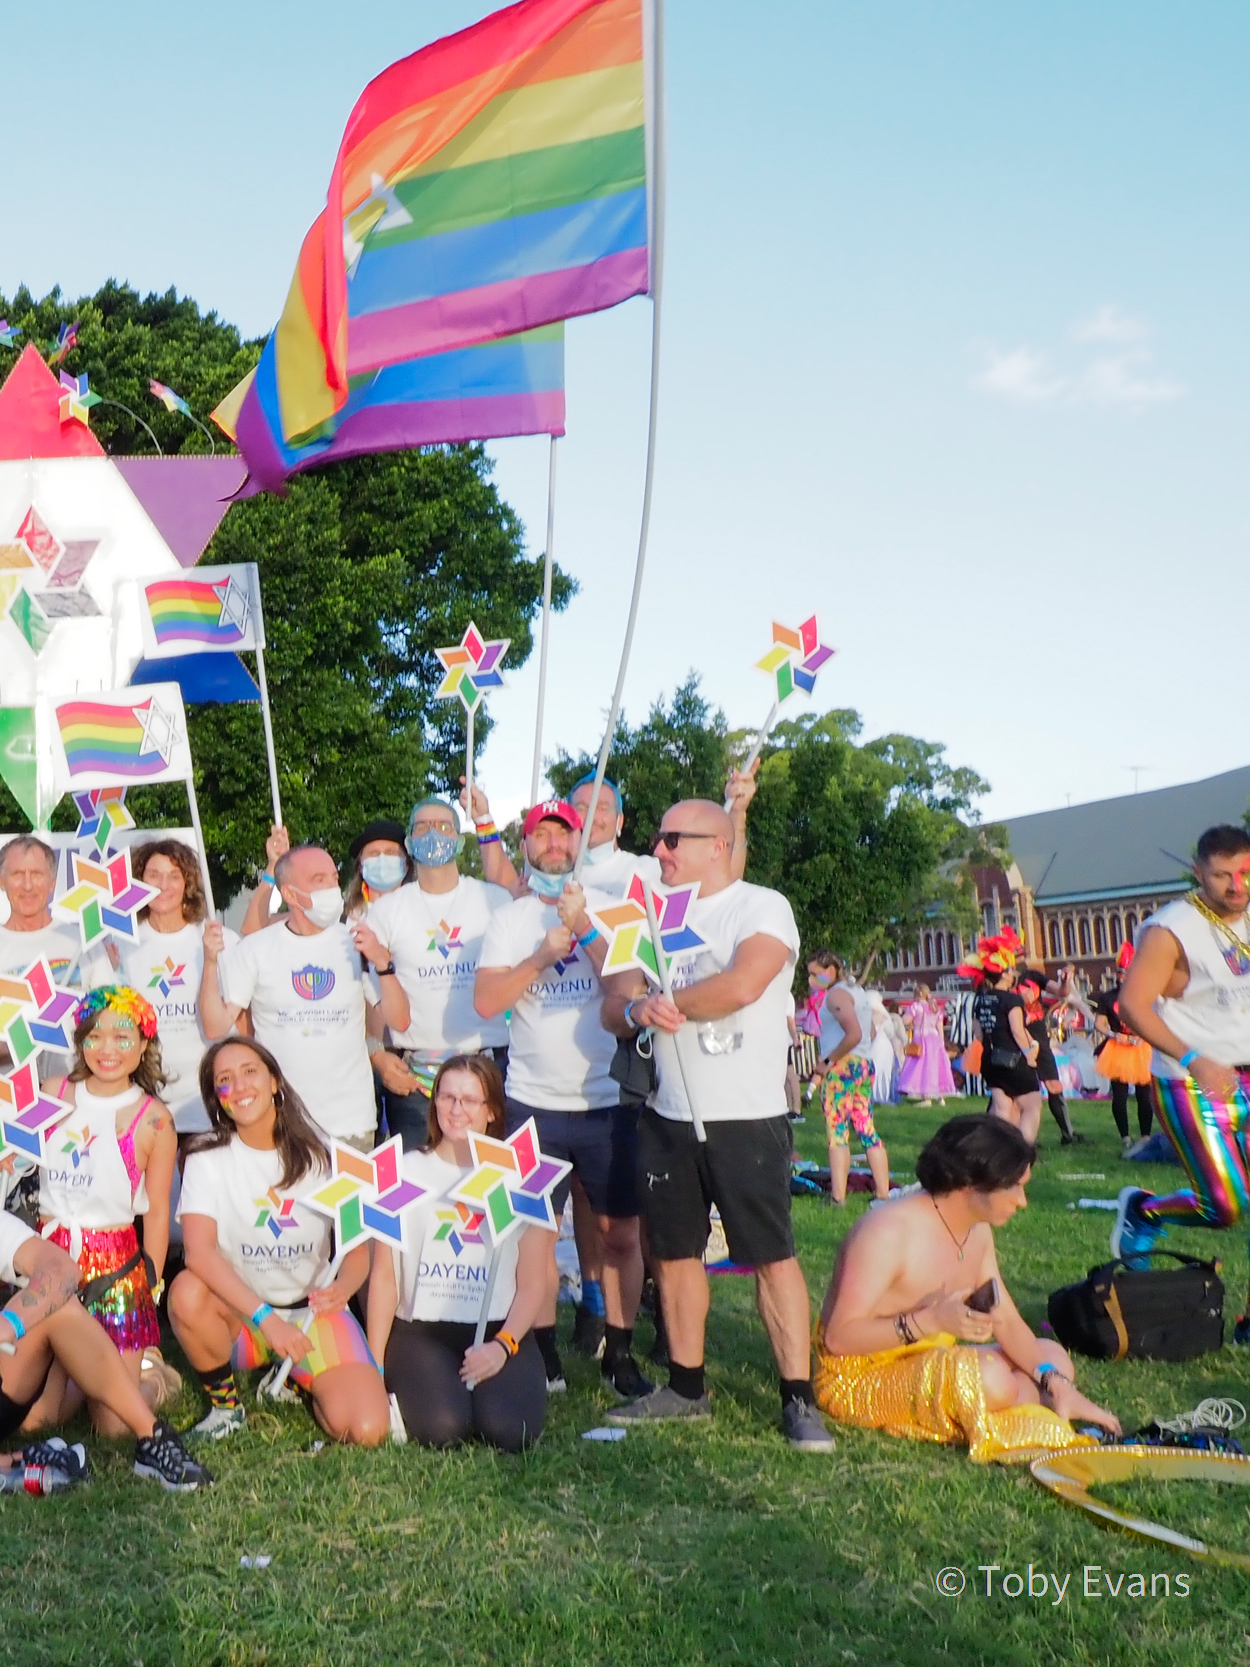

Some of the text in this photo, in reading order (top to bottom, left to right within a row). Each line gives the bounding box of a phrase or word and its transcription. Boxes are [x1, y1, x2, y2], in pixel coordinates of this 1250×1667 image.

[529, 978, 592, 995] DAYENU
[155, 1002, 197, 1017] YENU
[241, 1241, 314, 1258] DAYENU
